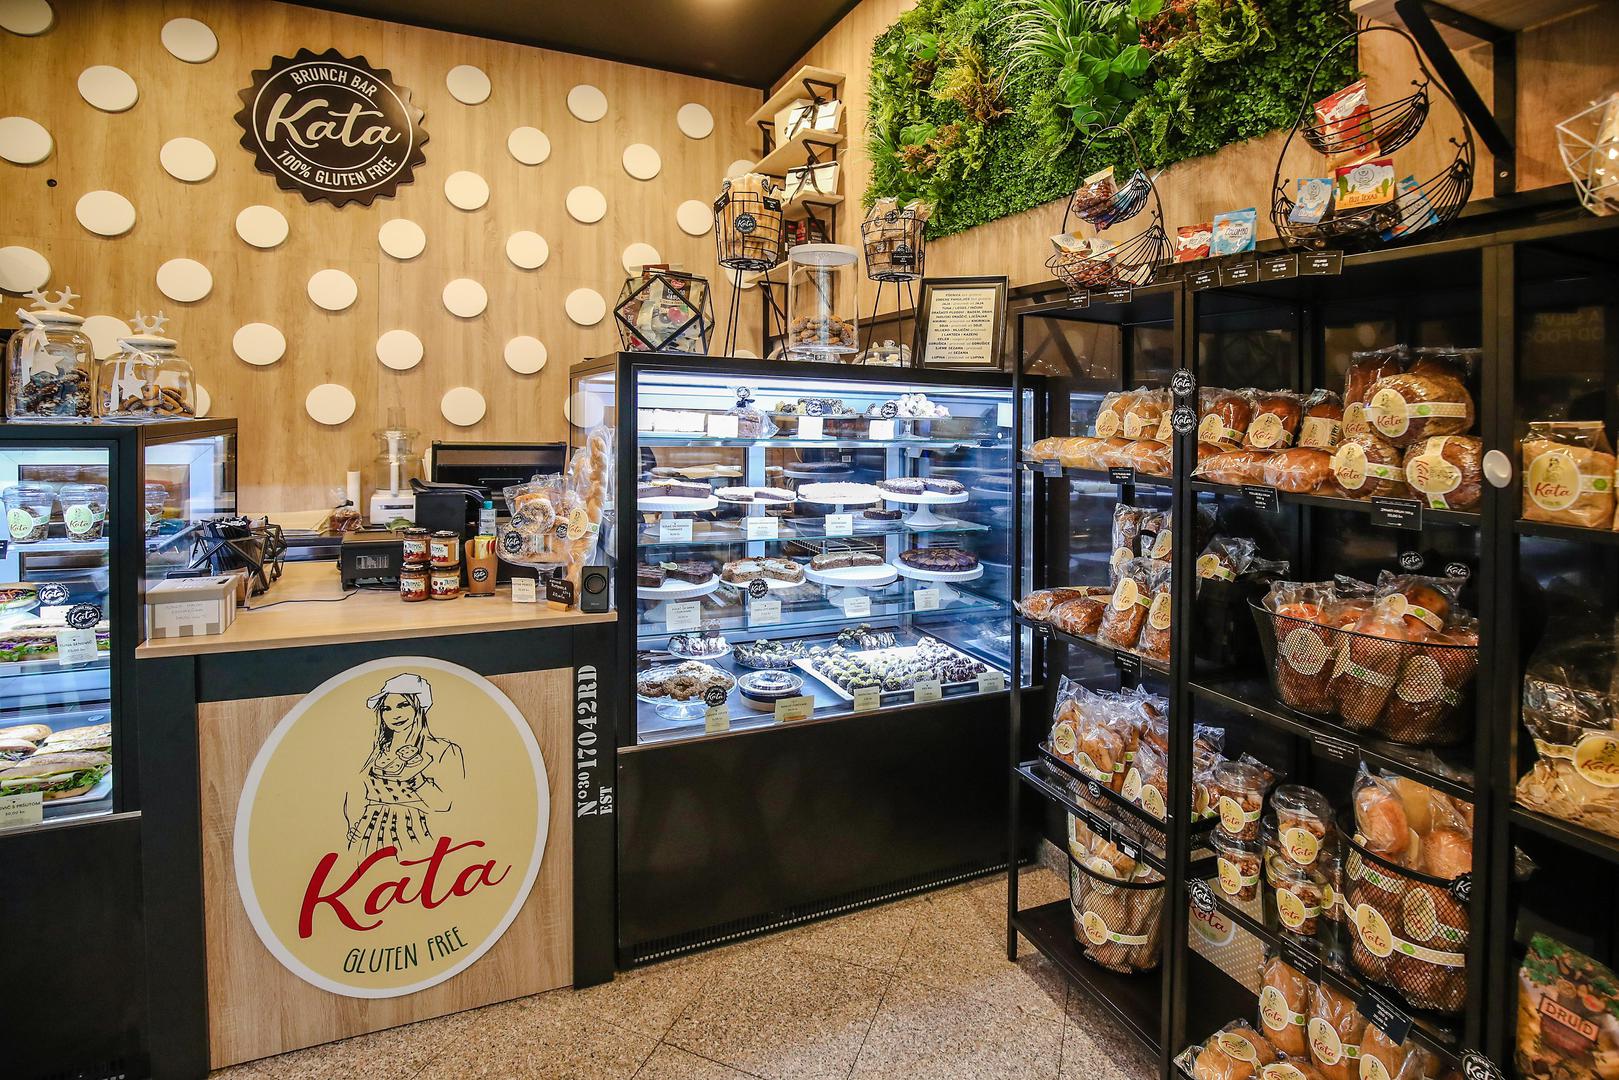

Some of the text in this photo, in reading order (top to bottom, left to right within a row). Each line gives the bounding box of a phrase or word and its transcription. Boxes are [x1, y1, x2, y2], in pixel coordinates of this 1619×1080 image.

[290, 67, 378, 97] BRUNCH BAR
[265, 92, 402, 149] Kata
[276, 150, 397, 186] 100% GLUTEN FREE
[737, 217, 753, 228] Kata
[1172, 376, 1191, 387] Kata
[1173, 414, 1192, 424] Kata
[1377, 414, 1403, 429] Kata
[1097, 424, 1114, 433] Kata
[1346, 422, 1366, 433] Kata
[1200, 431, 1216, 440] Kata
[1252, 430, 1274, 440] Kata
[1303, 438, 1320, 446] Kata
[1337, 466, 1360, 480] Kata
[1416, 460, 1430, 486] Kata
[1534, 482, 1573, 498] Kata
[10, 523, 28, 533] Kata
[69, 519, 89, 528] Kata
[1401, 555, 1422, 566] Kata
[1446, 565, 1467, 576] Kata
[41, 588, 65, 600] Kata
[71, 610, 97, 624] Kata
[707, 692, 723, 701] Kata
[1055, 735, 1071, 750] Kata
[599, 786, 613, 815] EST
[1144, 800, 1160, 816] Kata
[1222, 812, 1241, 825] Kata
[1291, 845, 1313, 857] Kata
[298, 836, 512, 939] Kata
[1220, 873, 1237, 888] Kata
[1192, 886, 1213, 905] Kata
[1279, 906, 1300, 920] Kata
[1086, 926, 1103, 940] Kata
[1361, 926, 1387, 948] Kata
[343, 926, 469, 974] GLUTEN FREE
[1262, 1006, 1283, 1022] Kata
[1545, 1002, 1594, 1036] DRUID
[1314, 1039, 1335, 1057] Kata
